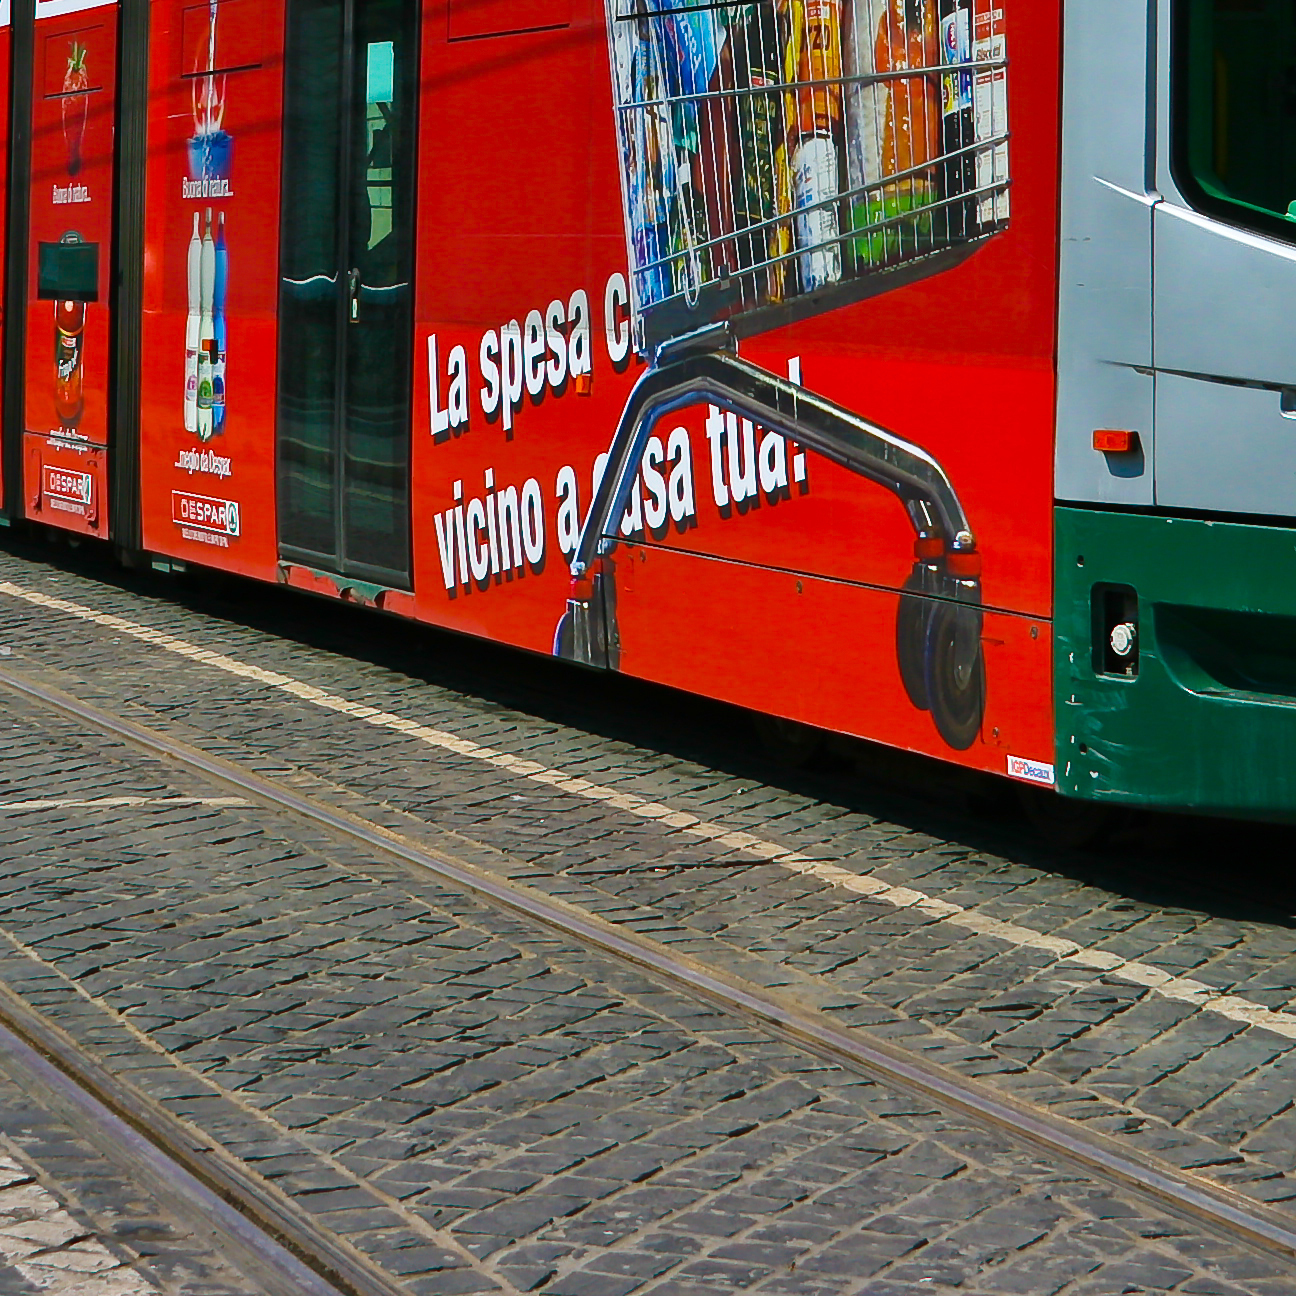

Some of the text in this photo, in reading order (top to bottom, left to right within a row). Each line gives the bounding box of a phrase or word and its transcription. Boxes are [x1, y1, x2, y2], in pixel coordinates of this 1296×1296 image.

[427, 333, 469, 436] La
[479, 288, 592, 432] spesa
[49, 472, 83, 496] DESPAR
[180, 498, 227, 526] DESPAR
[433, 467, 545, 591] vicino
[555, 465, 581, 555] a
